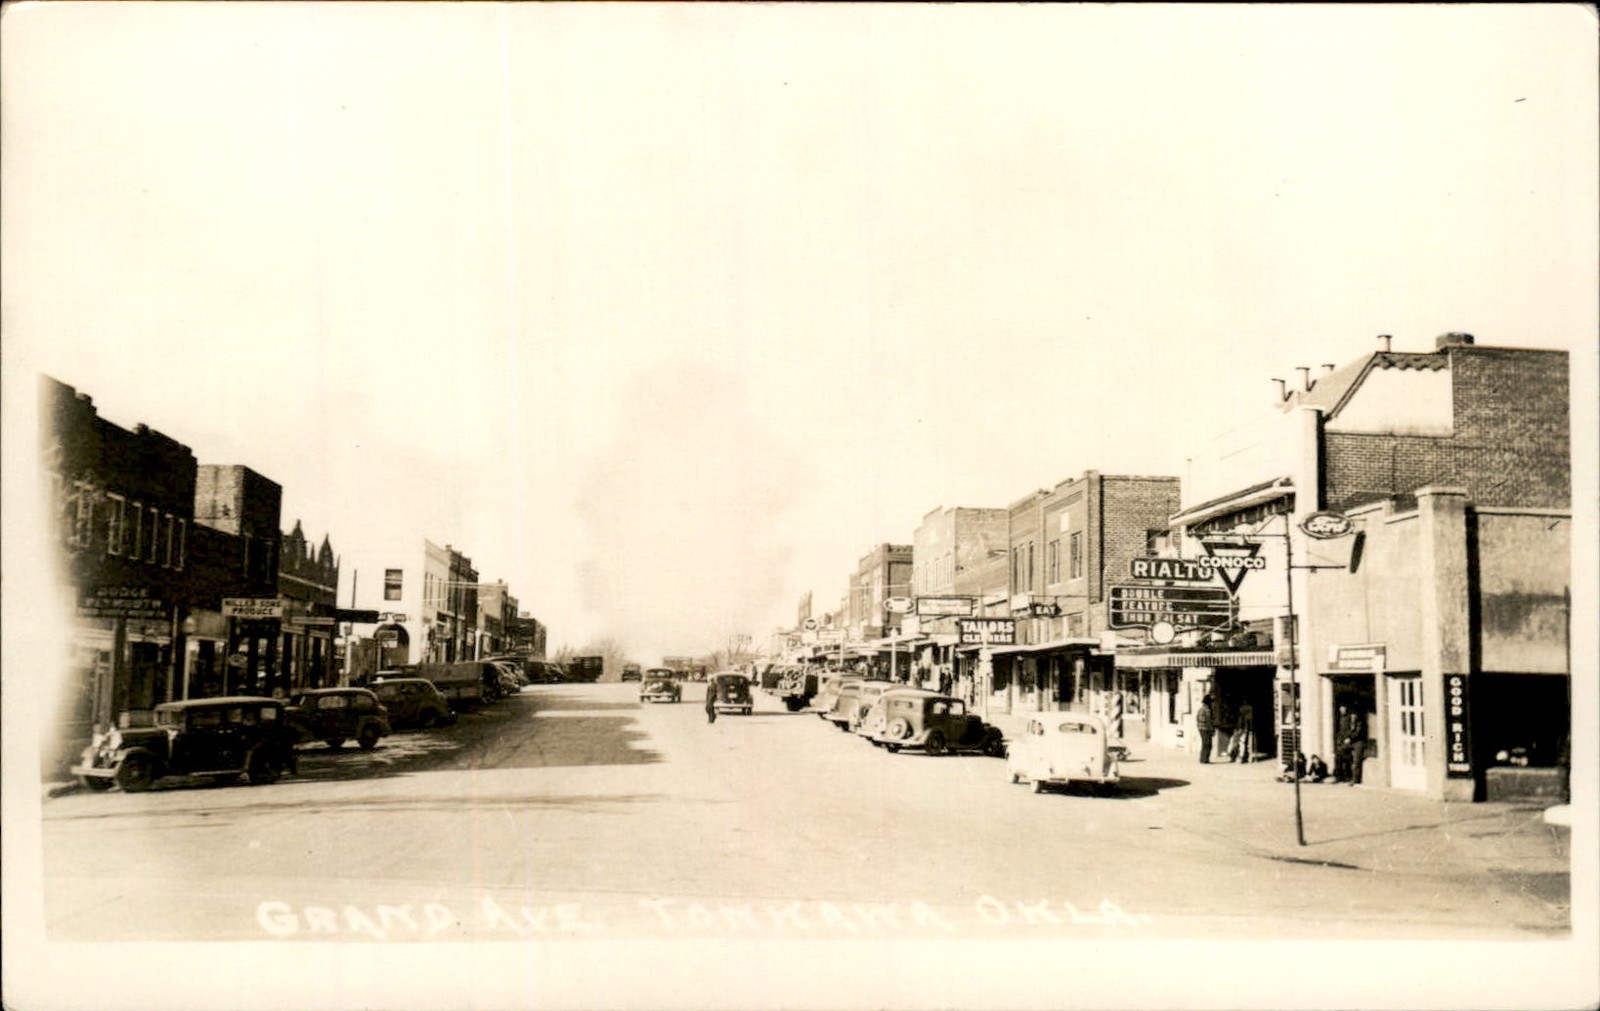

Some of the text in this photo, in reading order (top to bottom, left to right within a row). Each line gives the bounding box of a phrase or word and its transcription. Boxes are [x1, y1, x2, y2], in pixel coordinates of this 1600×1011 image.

[1308, 515, 1347, 536] Ford
[1200, 556, 1265, 569] CONOCO
[1134, 561, 1212, 579] RIALTO
[1121, 589, 1165, 599] DOUBLE
[1035, 606, 1056, 615] EAT
[1122, 601, 1173, 611] FEATURE
[232, 607, 274, 616] PRODUCE
[1177, 614, 1199, 624] SAT
[961, 621, 1014, 633] TAILORS
